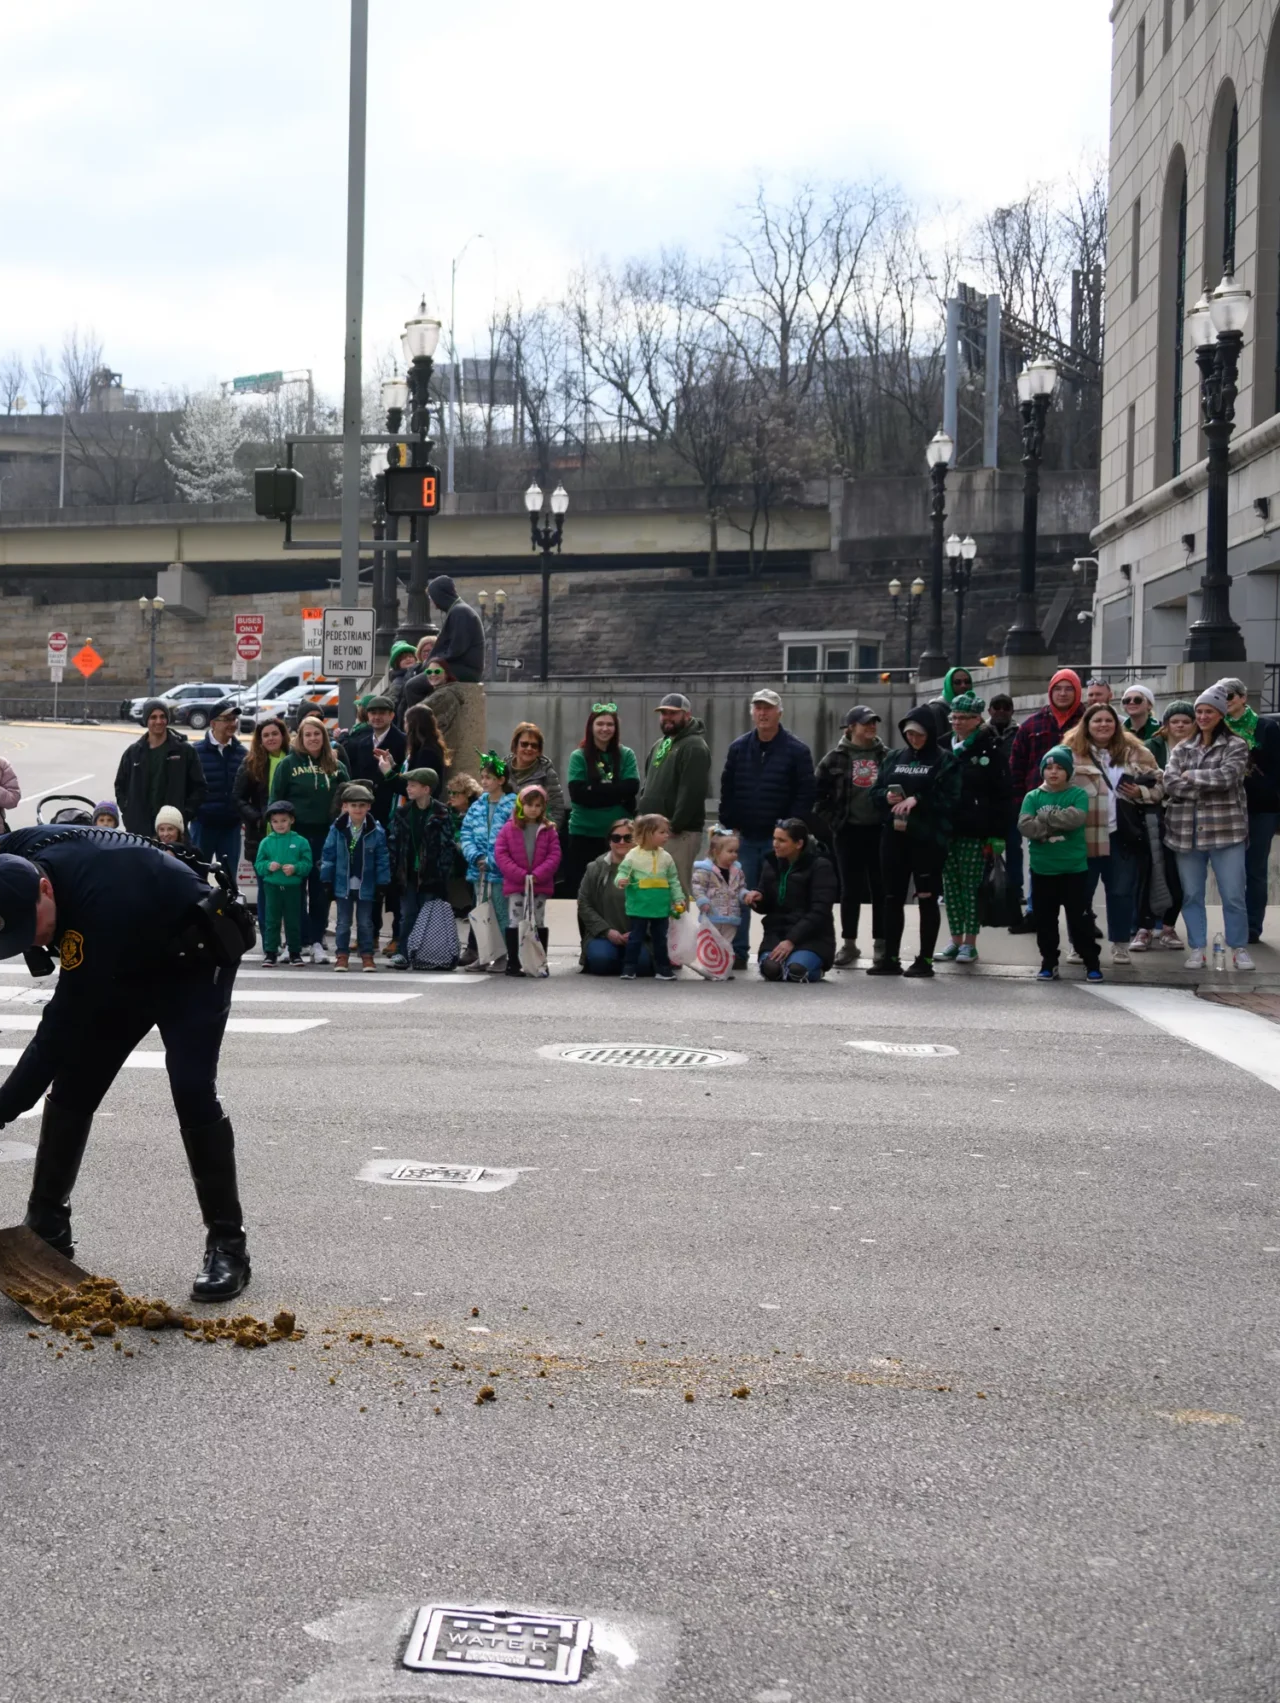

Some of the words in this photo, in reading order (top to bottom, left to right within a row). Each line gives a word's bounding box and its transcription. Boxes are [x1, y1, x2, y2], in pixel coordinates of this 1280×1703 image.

[423, 477, 436, 507] 8
[343, 616, 354, 626] NO
[325, 630, 372, 641] PEDESTRIANS
[333, 645, 363, 656] BEYOND
[328, 660, 344, 670] THIS
[346, 660, 368, 671] POINT
[448, 1632, 550, 1651] WATER
